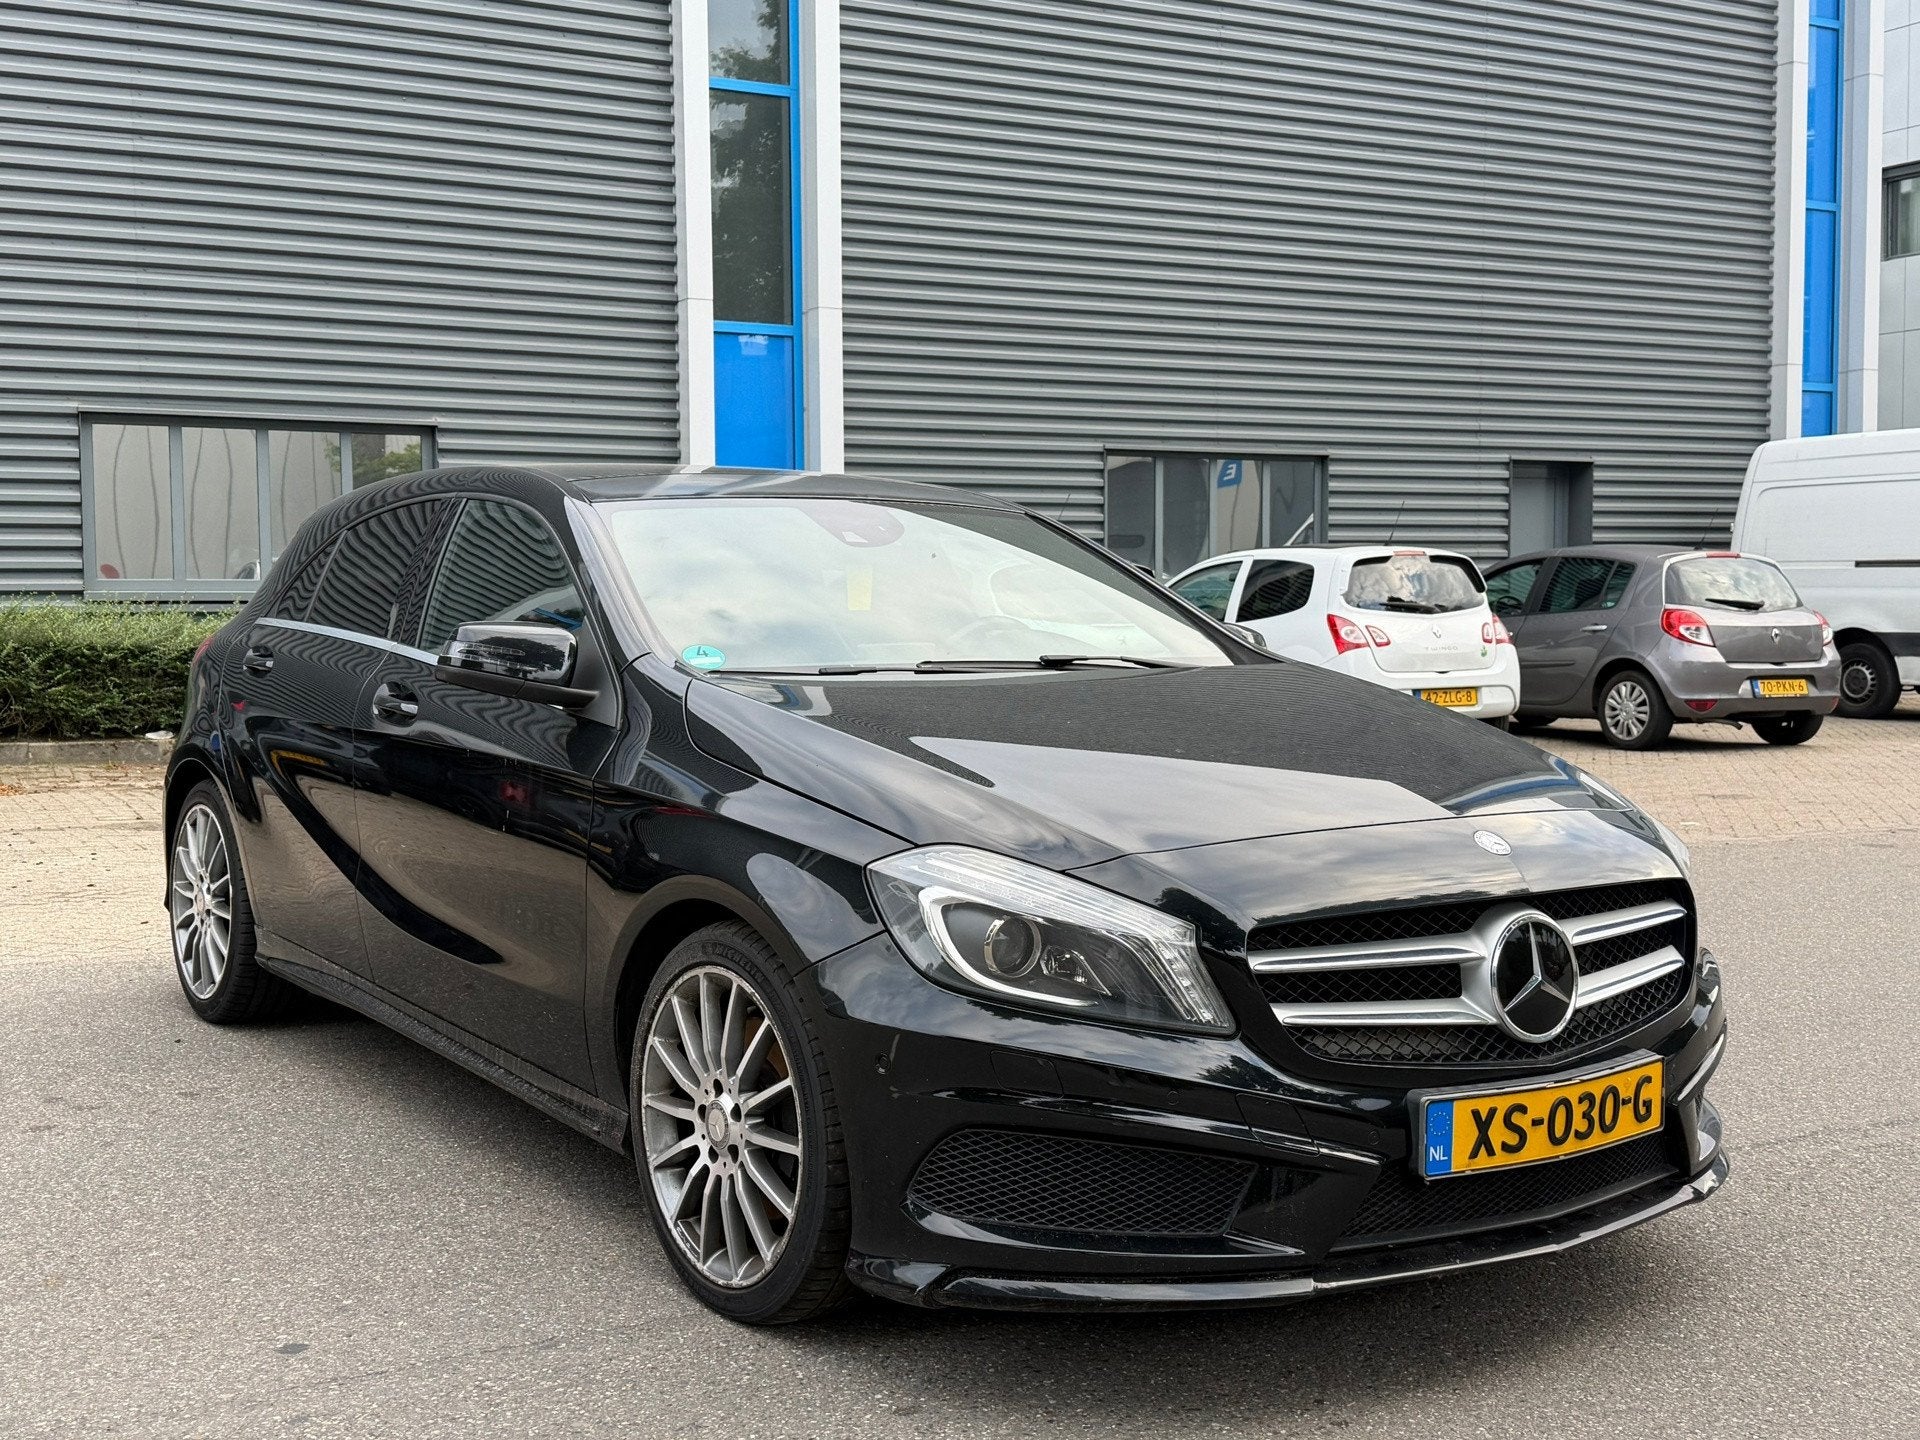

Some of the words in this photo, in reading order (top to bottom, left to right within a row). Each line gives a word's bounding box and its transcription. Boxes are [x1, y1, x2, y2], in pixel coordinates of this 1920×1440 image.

[696, 645, 709, 658] 4
[1760, 681, 1804, 693] 70-PKN-6
[1425, 690, 1473, 704] 42-ZLG-8
[1467, 1074, 1654, 1160] XS-030-G
[1429, 1145, 1449, 1162] NL
